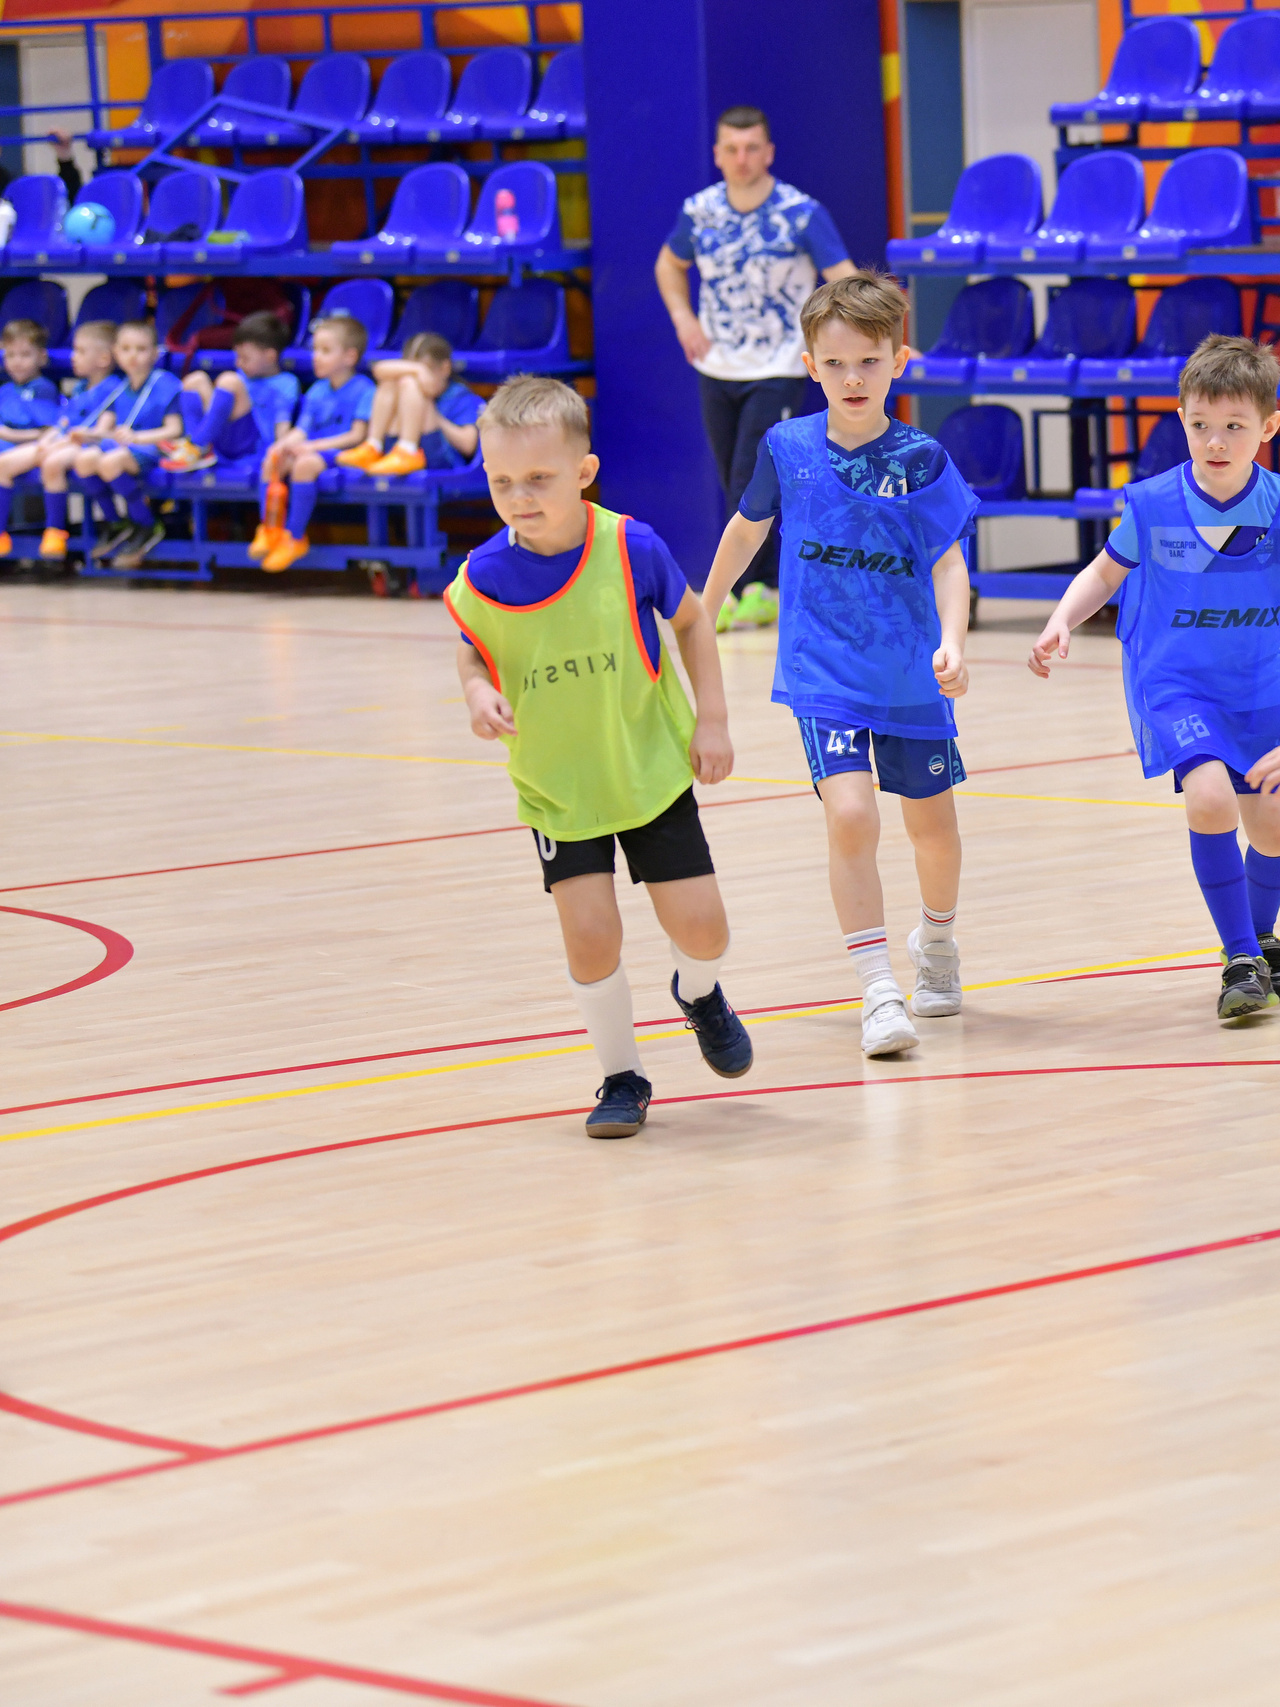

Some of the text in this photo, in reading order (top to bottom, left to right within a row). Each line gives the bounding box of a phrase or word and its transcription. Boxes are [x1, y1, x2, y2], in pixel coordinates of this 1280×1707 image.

[877, 475, 909, 505] 41
[798, 539, 915, 578] DEMIX
[826, 730, 859, 755] 41
[1172, 713, 1211, 748] 28
